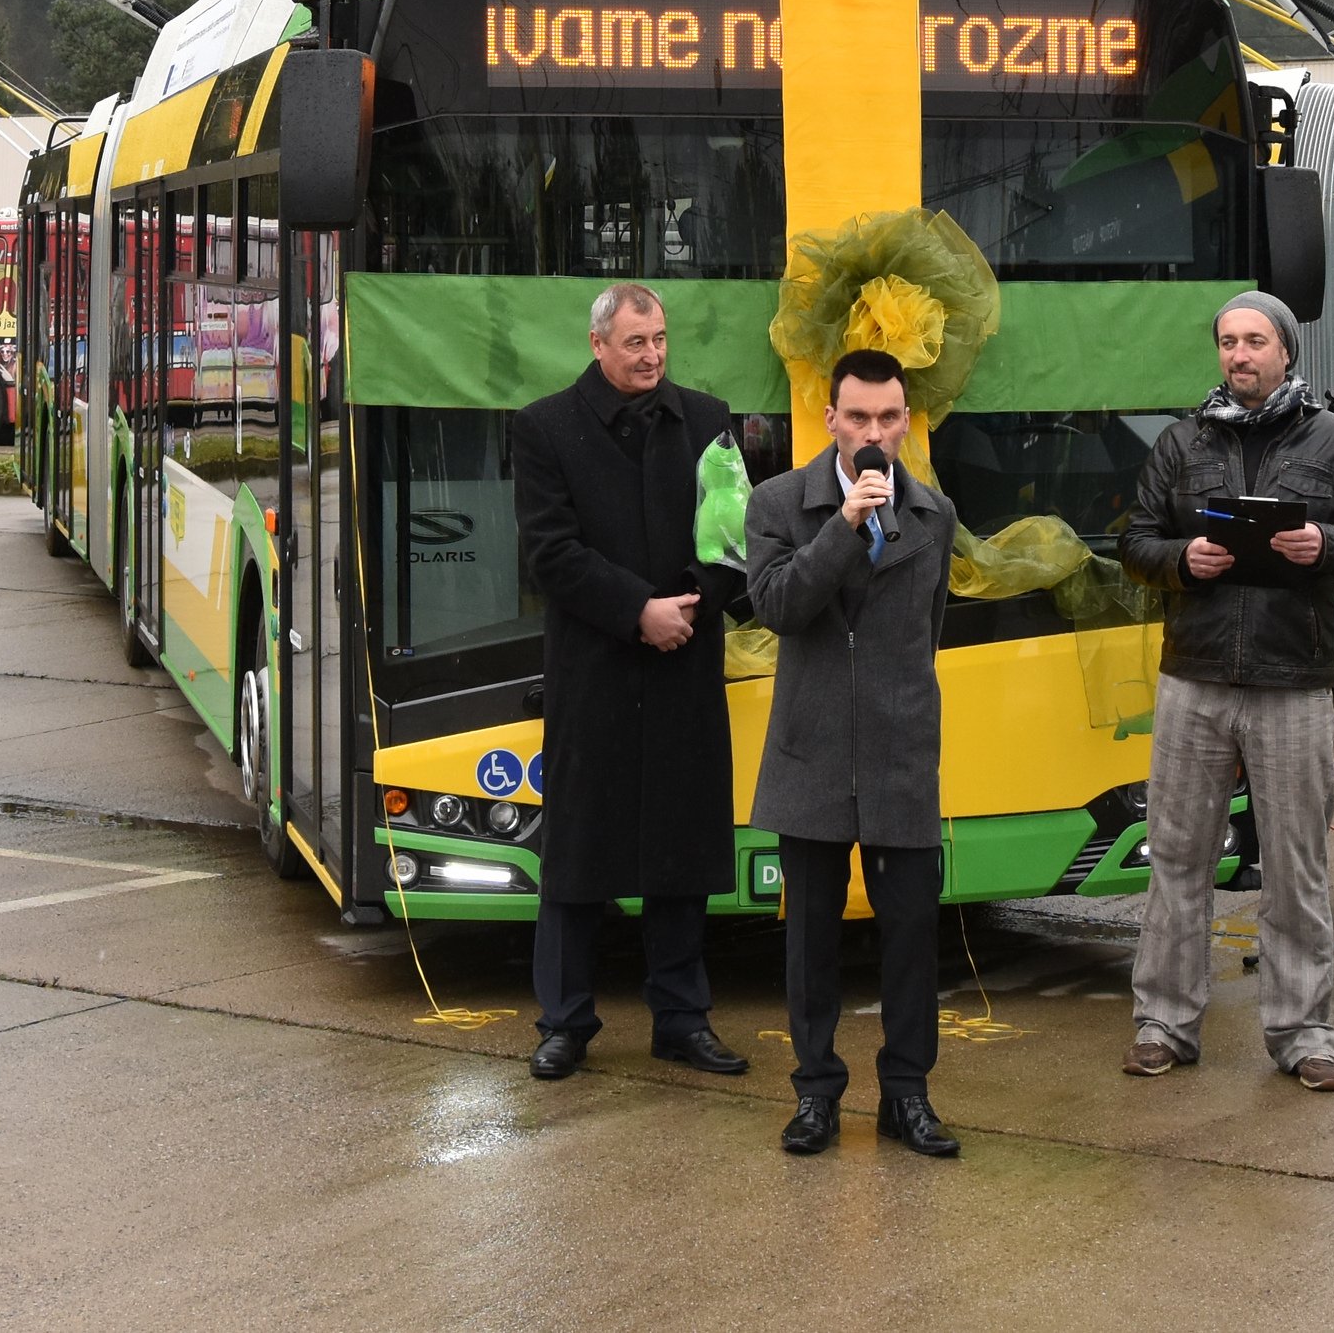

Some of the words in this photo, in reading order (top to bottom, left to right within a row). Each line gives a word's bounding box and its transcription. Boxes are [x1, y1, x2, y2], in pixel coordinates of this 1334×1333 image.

[0, 223, 18, 231] mest
[410, 551, 476, 563] OLARIS
[762, 865, 783, 884] D
